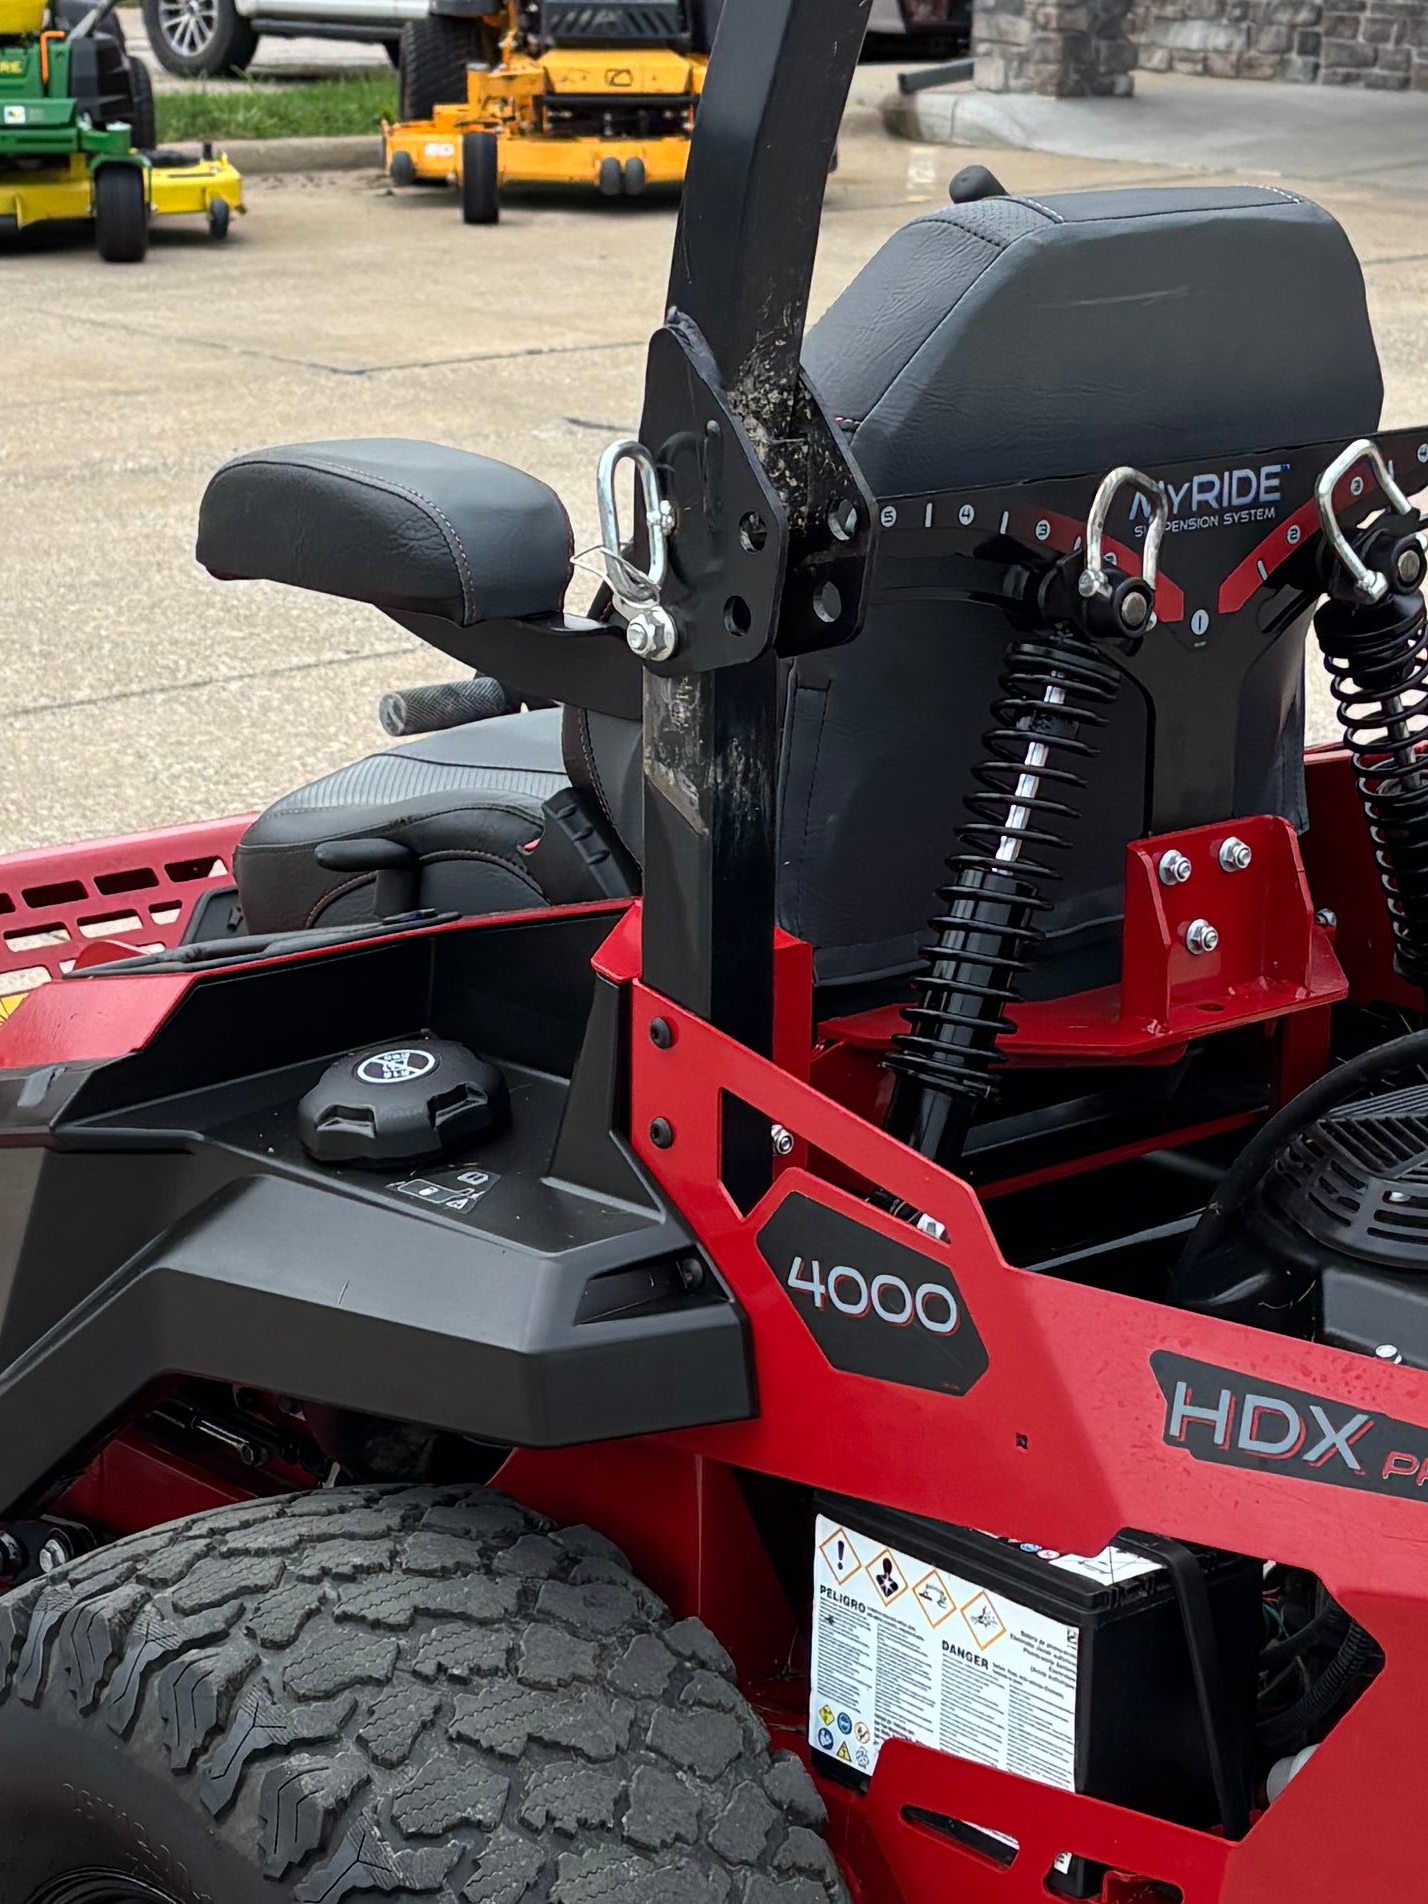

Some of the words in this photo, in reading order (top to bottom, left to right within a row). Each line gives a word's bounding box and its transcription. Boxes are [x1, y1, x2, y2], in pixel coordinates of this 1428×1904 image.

[1223, 507, 1276, 526] SYSTEM
[787, 1256, 960, 1336] 4000
[1169, 1381, 1373, 1474] HDX
[819, 1584, 867, 1615] PELIGRO
[941, 1639, 990, 1671] DANGER
